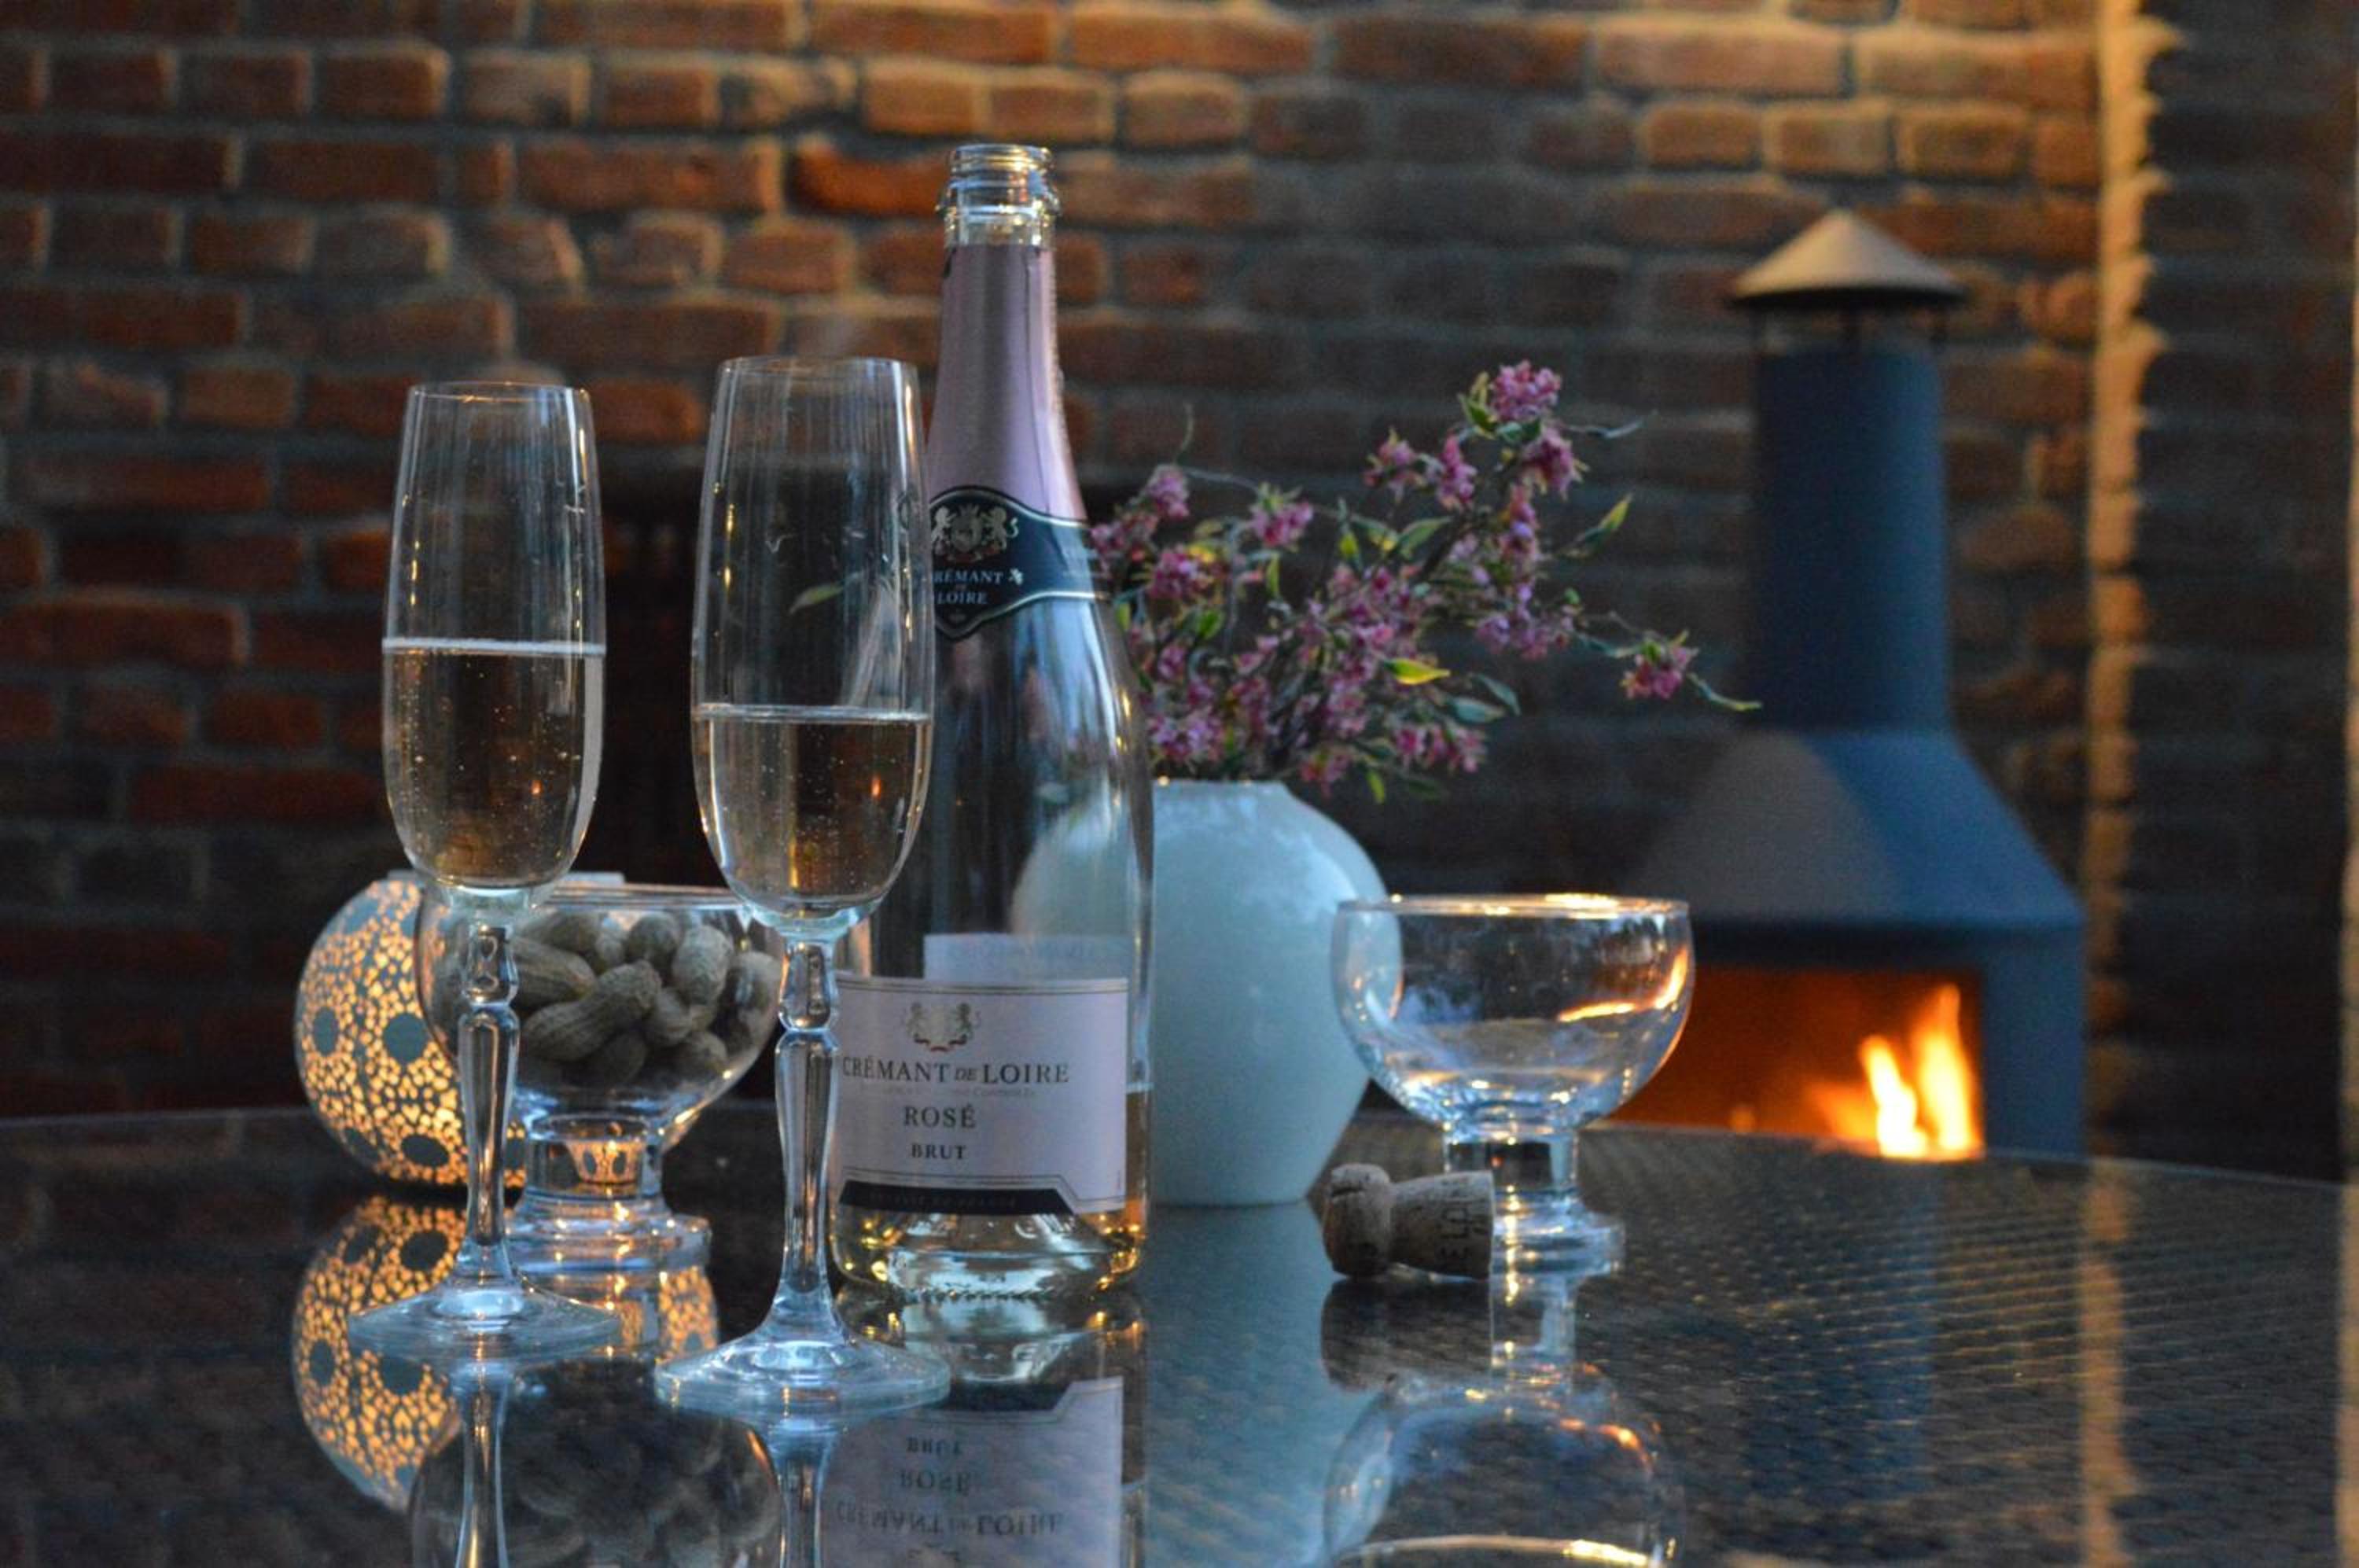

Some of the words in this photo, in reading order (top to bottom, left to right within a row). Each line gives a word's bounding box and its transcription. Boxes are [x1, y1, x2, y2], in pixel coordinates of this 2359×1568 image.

[933, 569, 1003, 584] RÉMANT
[937, 591, 988, 605] LOIRE
[842, 1056, 949, 1082] CRÉMANT
[955, 1067, 977, 1081] DE
[983, 1063, 1069, 1085] LOIRE
[903, 1104, 977, 1128] ROSÉ
[911, 1142, 966, 1160] BRUT
